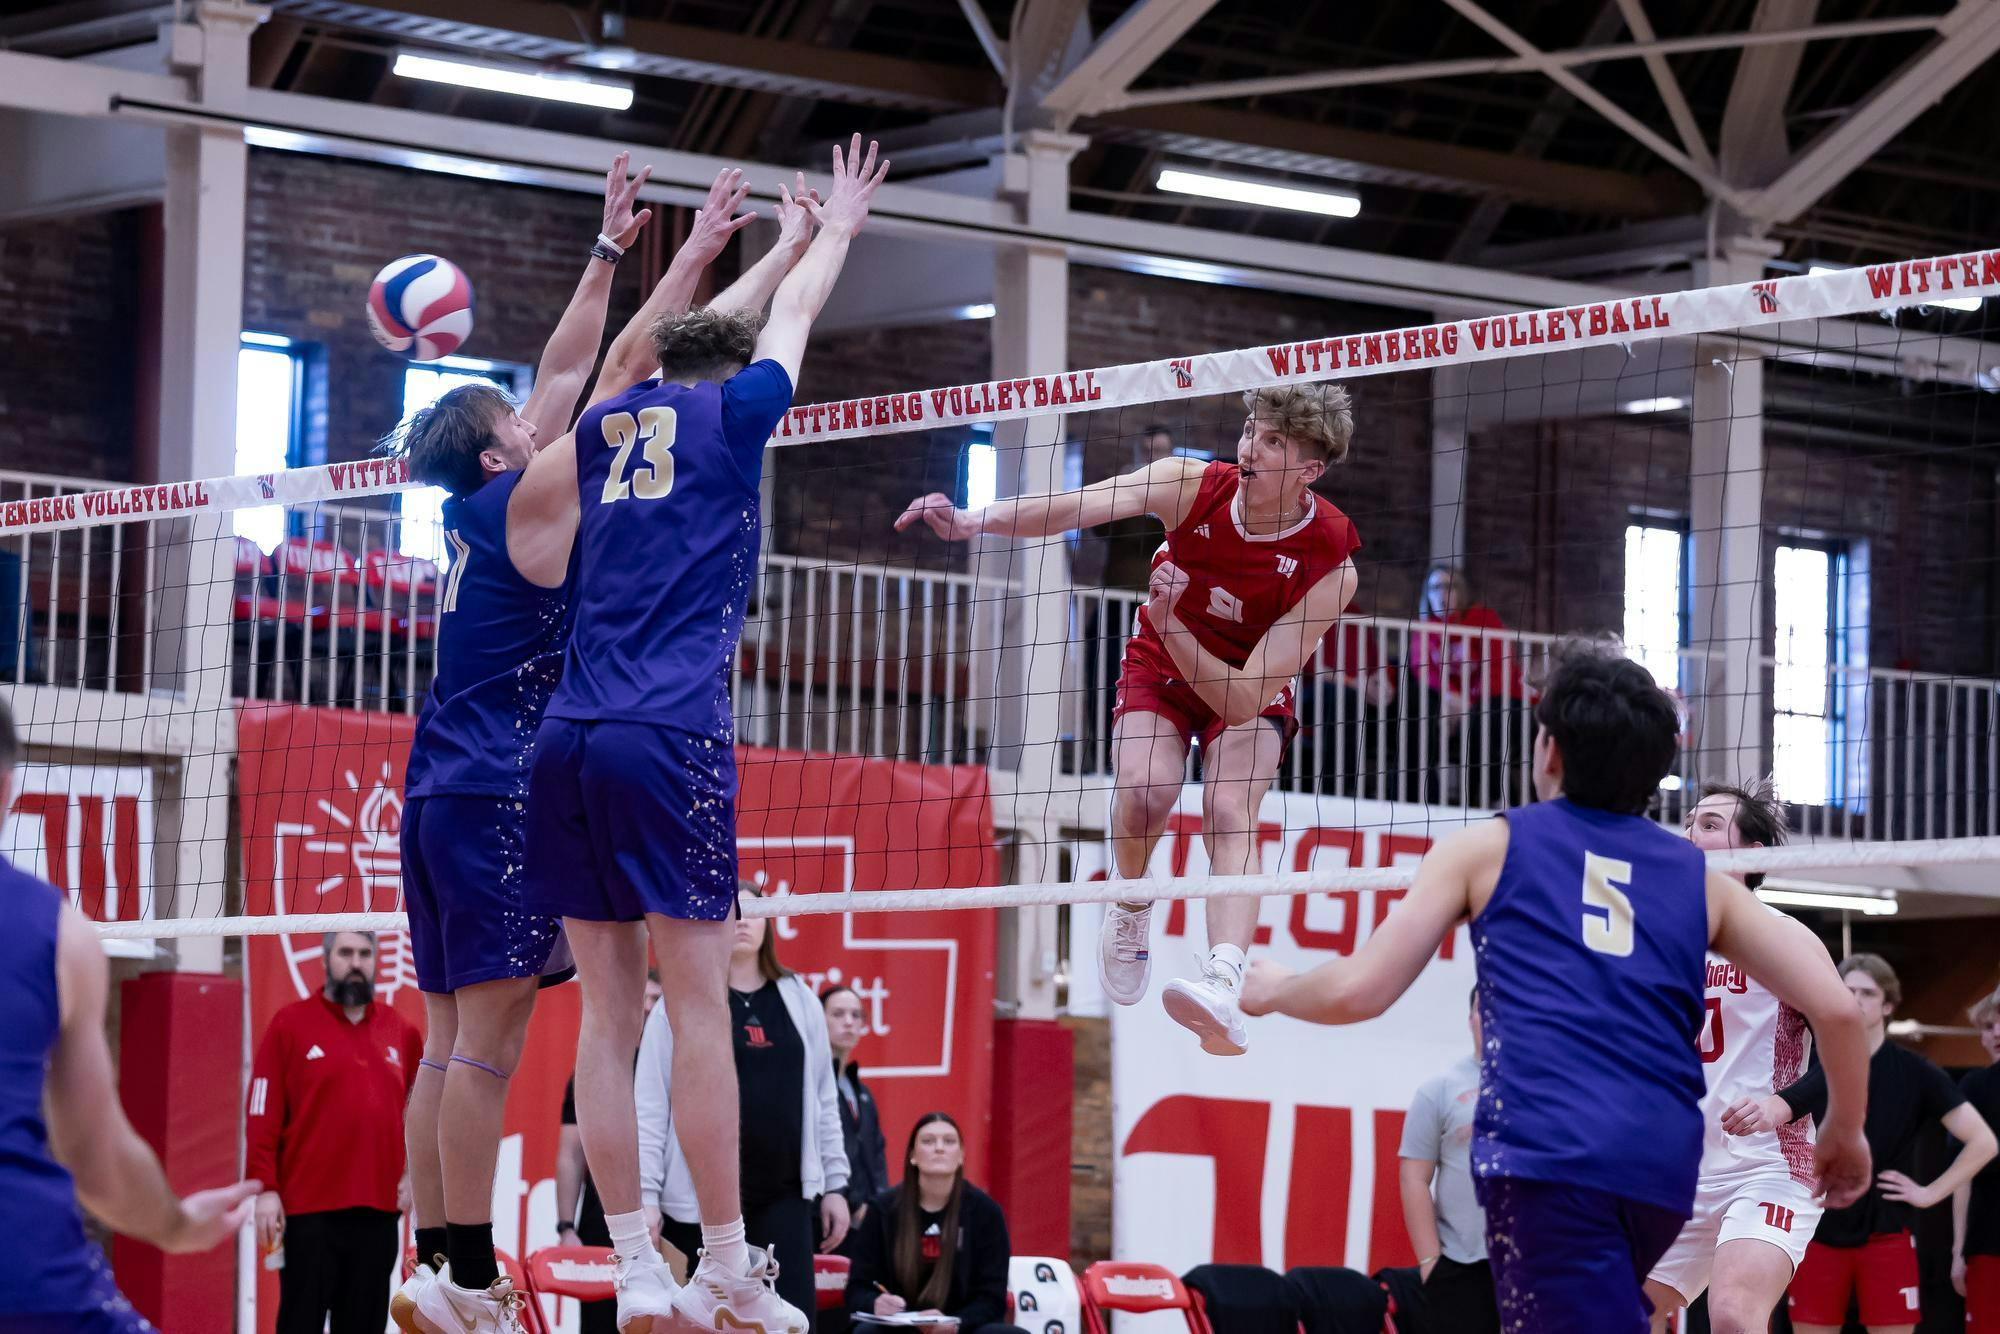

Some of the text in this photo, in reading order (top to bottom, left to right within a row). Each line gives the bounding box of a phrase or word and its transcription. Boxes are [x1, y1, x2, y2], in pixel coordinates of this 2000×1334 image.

[1267, 297, 1670, 378] WITTENBERG VOLLEYBALL
[771, 371, 1101, 438] ITTENBERG VOLLEYBALL
[601, 406, 677, 504] 23
[0, 481, 209, 528] ENBERG VOLLEYBALL
[1582, 850, 1635, 957] 5
